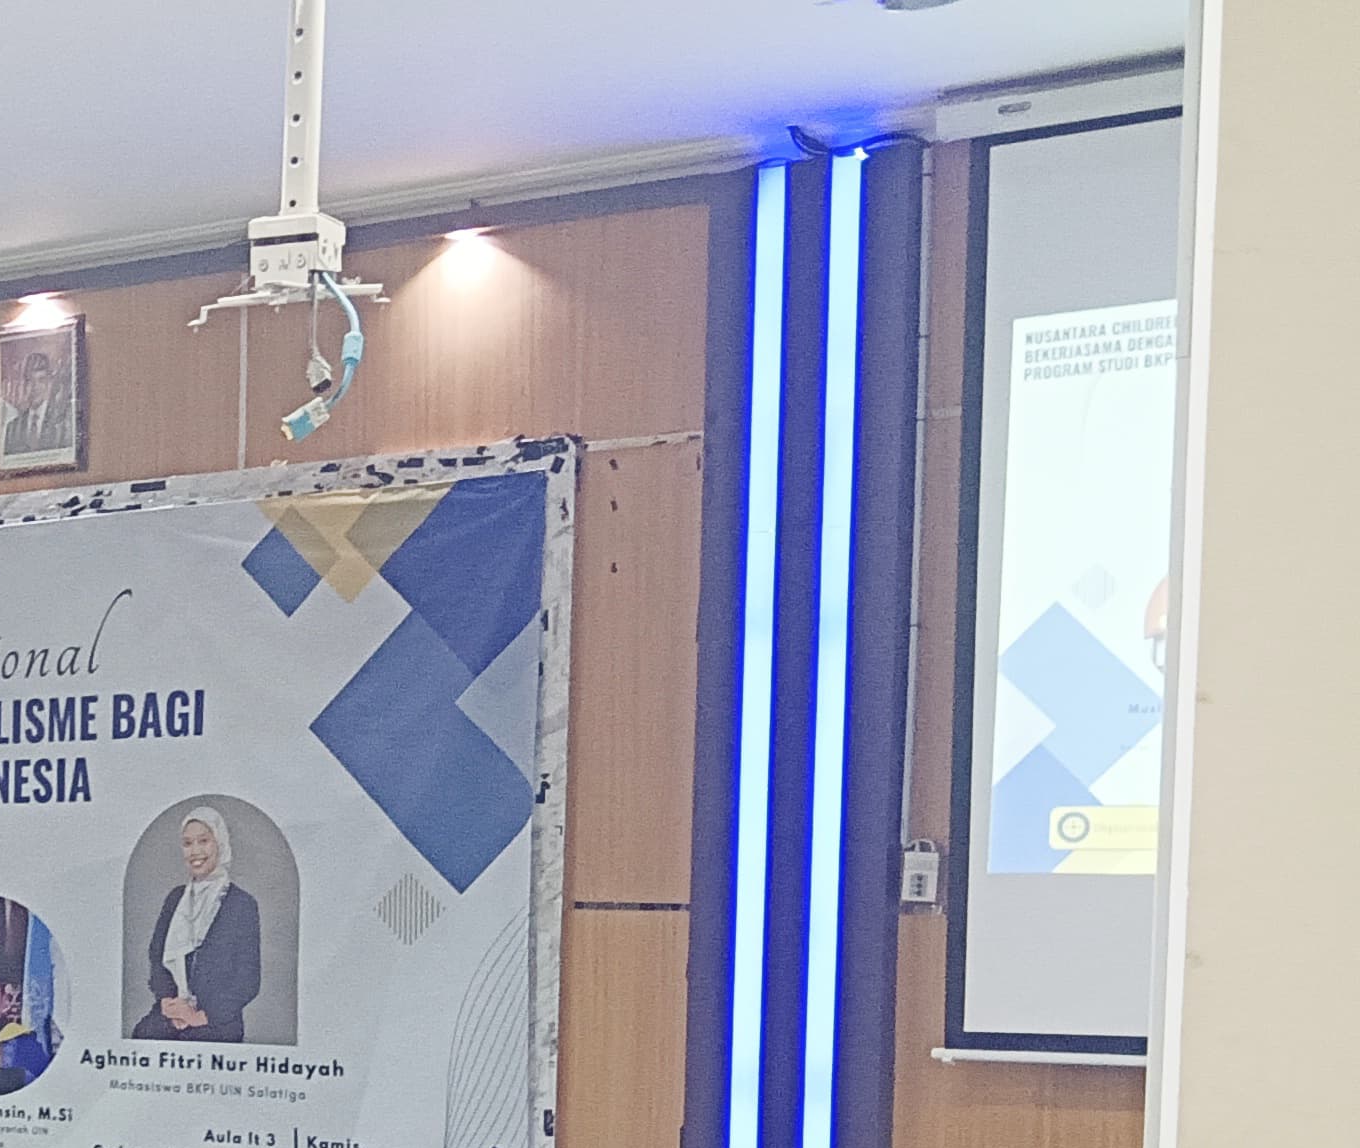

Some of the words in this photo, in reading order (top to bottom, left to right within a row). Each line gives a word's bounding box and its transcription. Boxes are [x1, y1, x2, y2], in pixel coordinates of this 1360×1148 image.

[1024, 323, 1107, 345] NUSANTARA
[1024, 340, 1122, 364] BEKERJASAMA
[1024, 361, 1093, 381] PROGRAM
[1099, 357, 1139, 374] STUDI
[112, 689, 205, 740] BAGI
[80, 1049, 150, 1069] Aghnia
[159, 1052, 202, 1070] Fitri
[211, 1054, 247, 1072] Nur
[256, 1056, 344, 1079] Hidayah
[109, 1079, 181, 1094] Mahasiswa
[186, 1082, 215, 1095] BKPI
[220, 1084, 242, 1097] UIN
[247, 1085, 306, 1102] Salatiga
[38, 1107, 73, 1123] M.Si
[204, 1129, 241, 1144] Aula
[266, 1132, 276, 1147] 3
